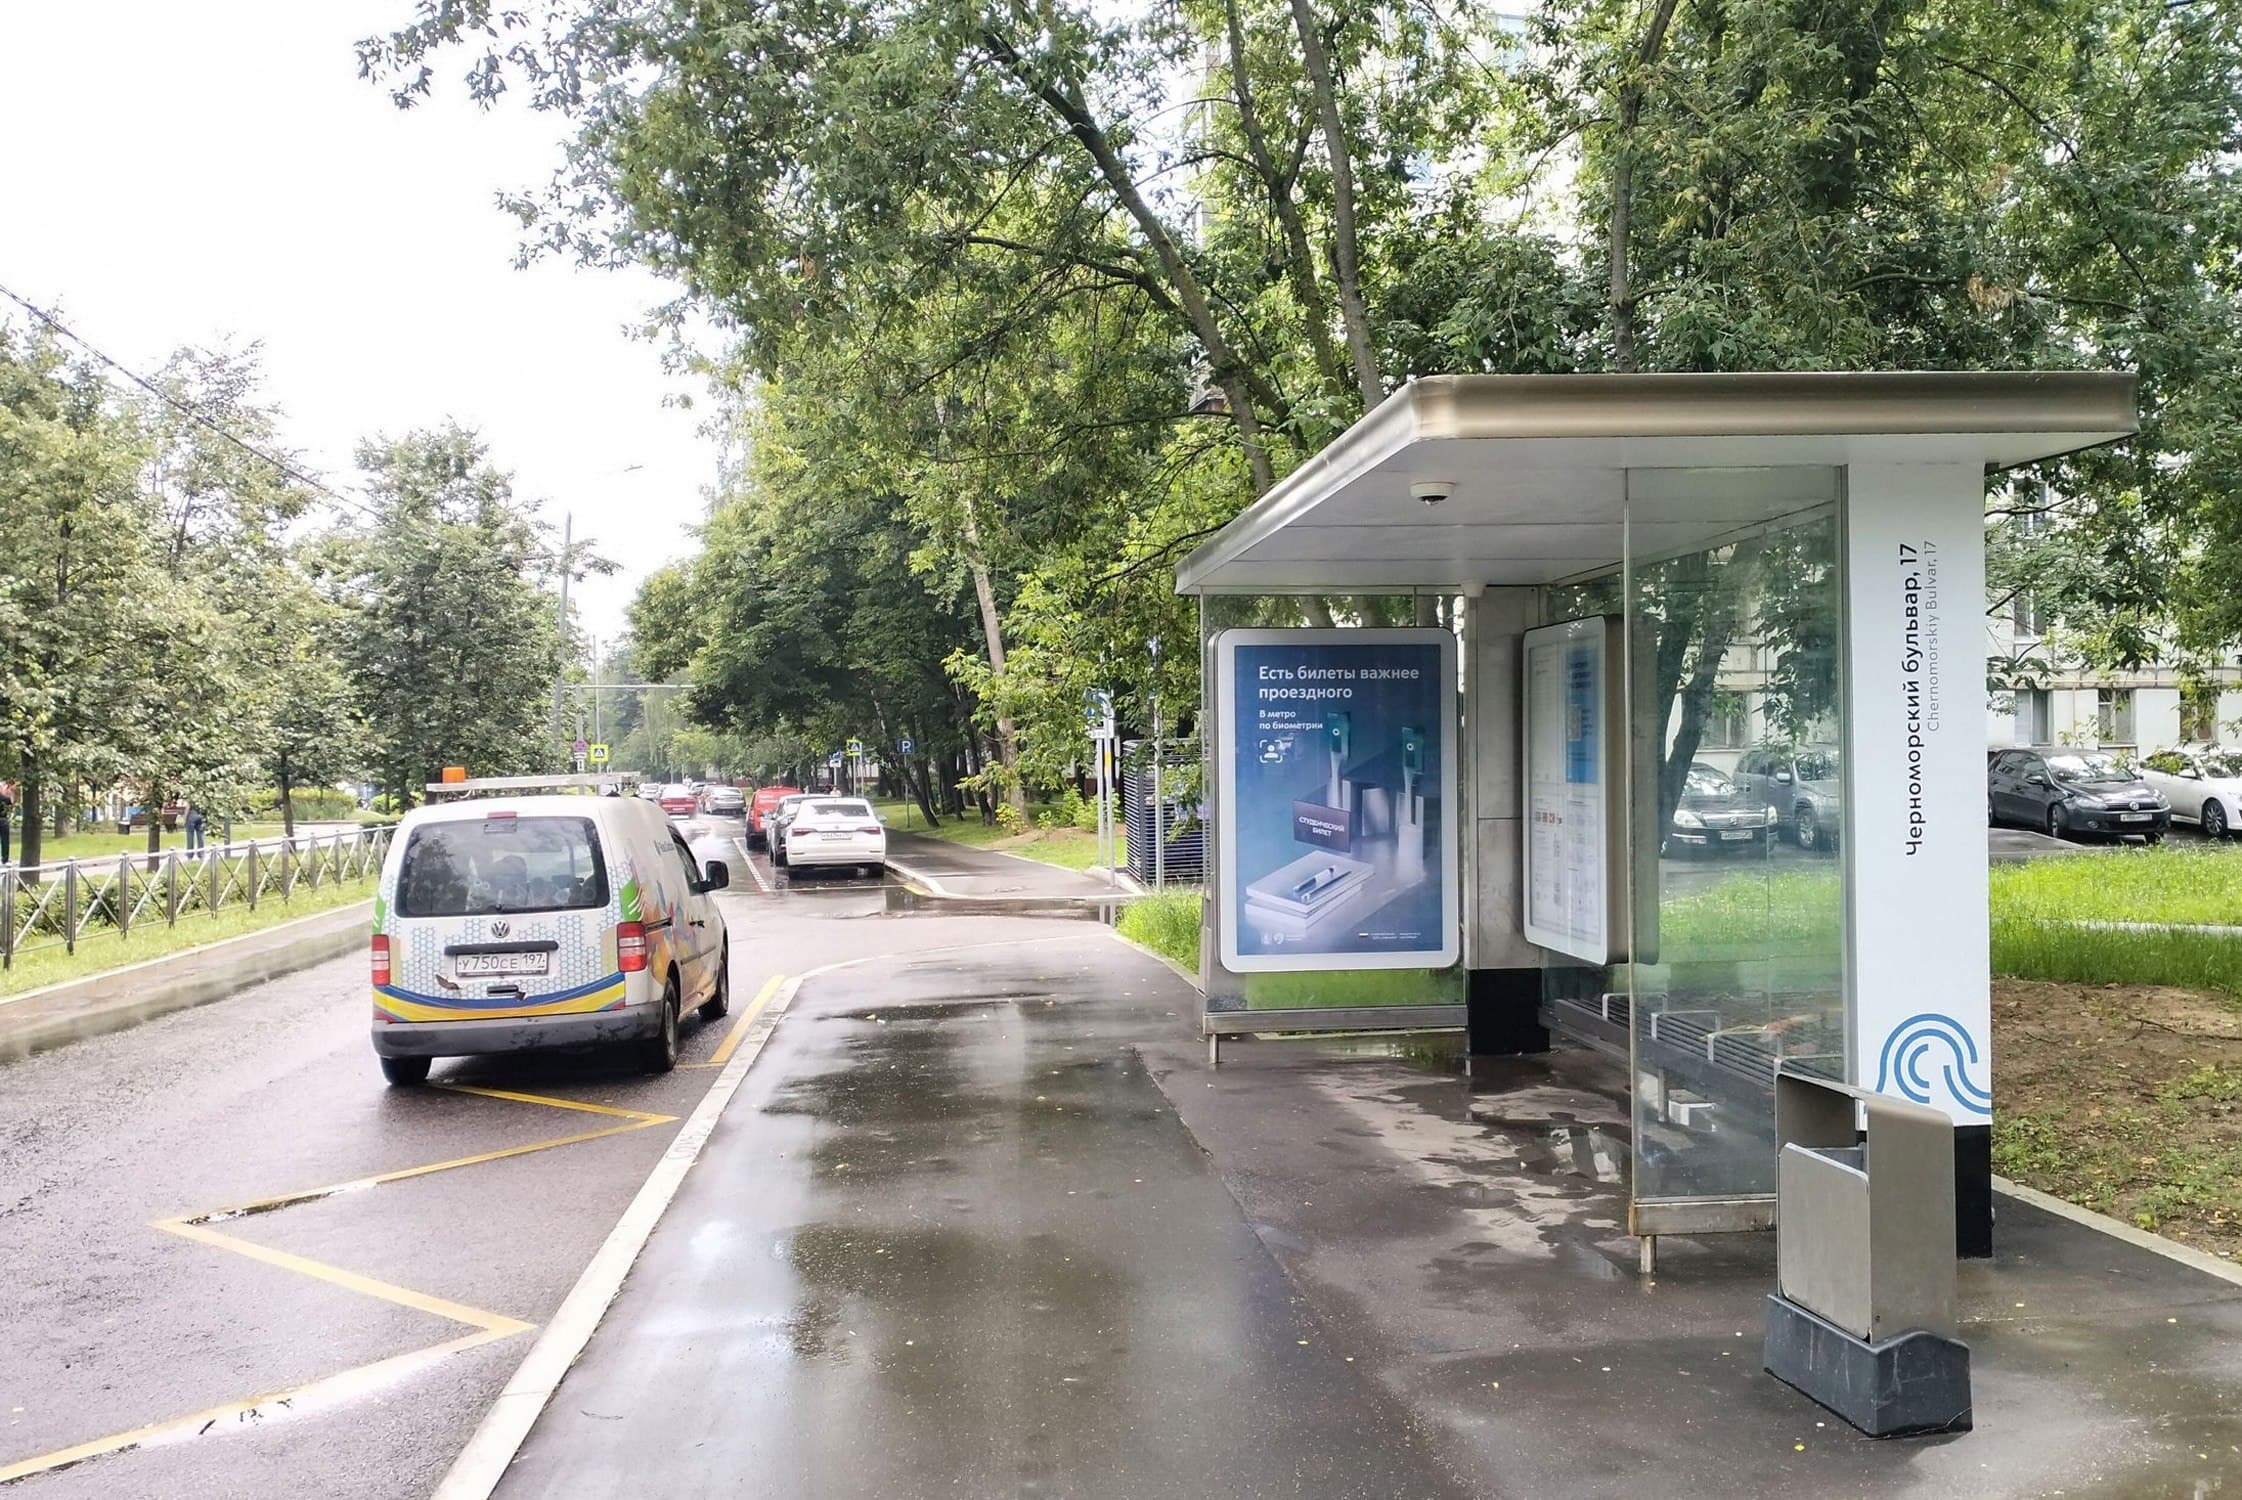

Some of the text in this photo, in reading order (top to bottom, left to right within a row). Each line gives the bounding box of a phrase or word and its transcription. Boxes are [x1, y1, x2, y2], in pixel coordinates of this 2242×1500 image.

[1924, 540, 1940, 732] Chernomorskiy Bulvar, 17
[1259, 665, 1419, 680] Есть билеты важнее
[1259, 687, 1352, 701] проездного
[1899, 543, 1926, 856] Черноморский бульвар, 17
[1259, 709, 1297, 720] В метро
[1259, 720, 1323, 732] по биометрии
[901, 740, 912, 753] P
[522, 953, 543, 965] 197
